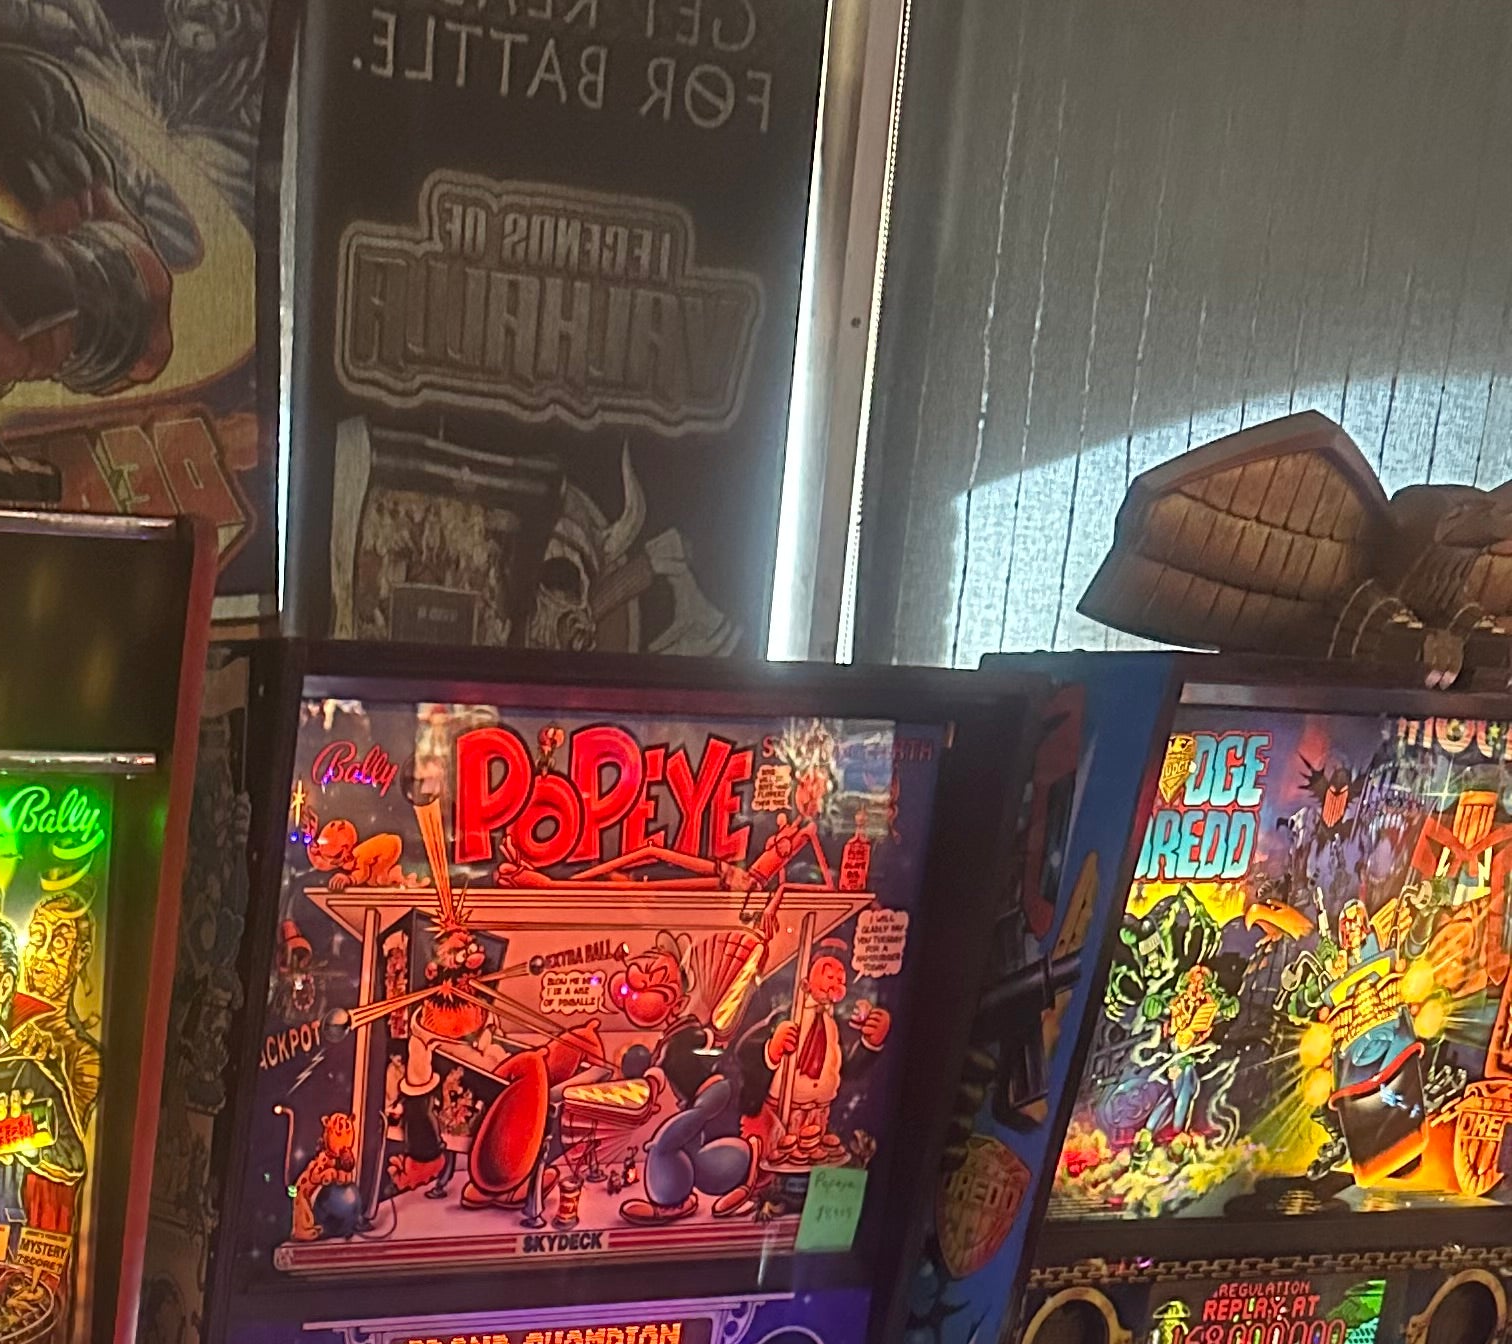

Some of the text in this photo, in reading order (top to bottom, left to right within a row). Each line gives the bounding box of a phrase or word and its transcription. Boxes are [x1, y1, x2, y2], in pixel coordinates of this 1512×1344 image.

[311, 738, 399, 798] Bally
[1183, 733, 1270, 807] DGE
[6, 784, 102, 843] Bally
[259, 1020, 321, 1071] ACKPOT
[20, 1237, 68, 1260] MYSTERY
[522, 1231, 603, 1254] SKYDECK
[1202, 1294, 1321, 1323] REPLAY AT
[1218, 1280, 1312, 1299] REGULATION
